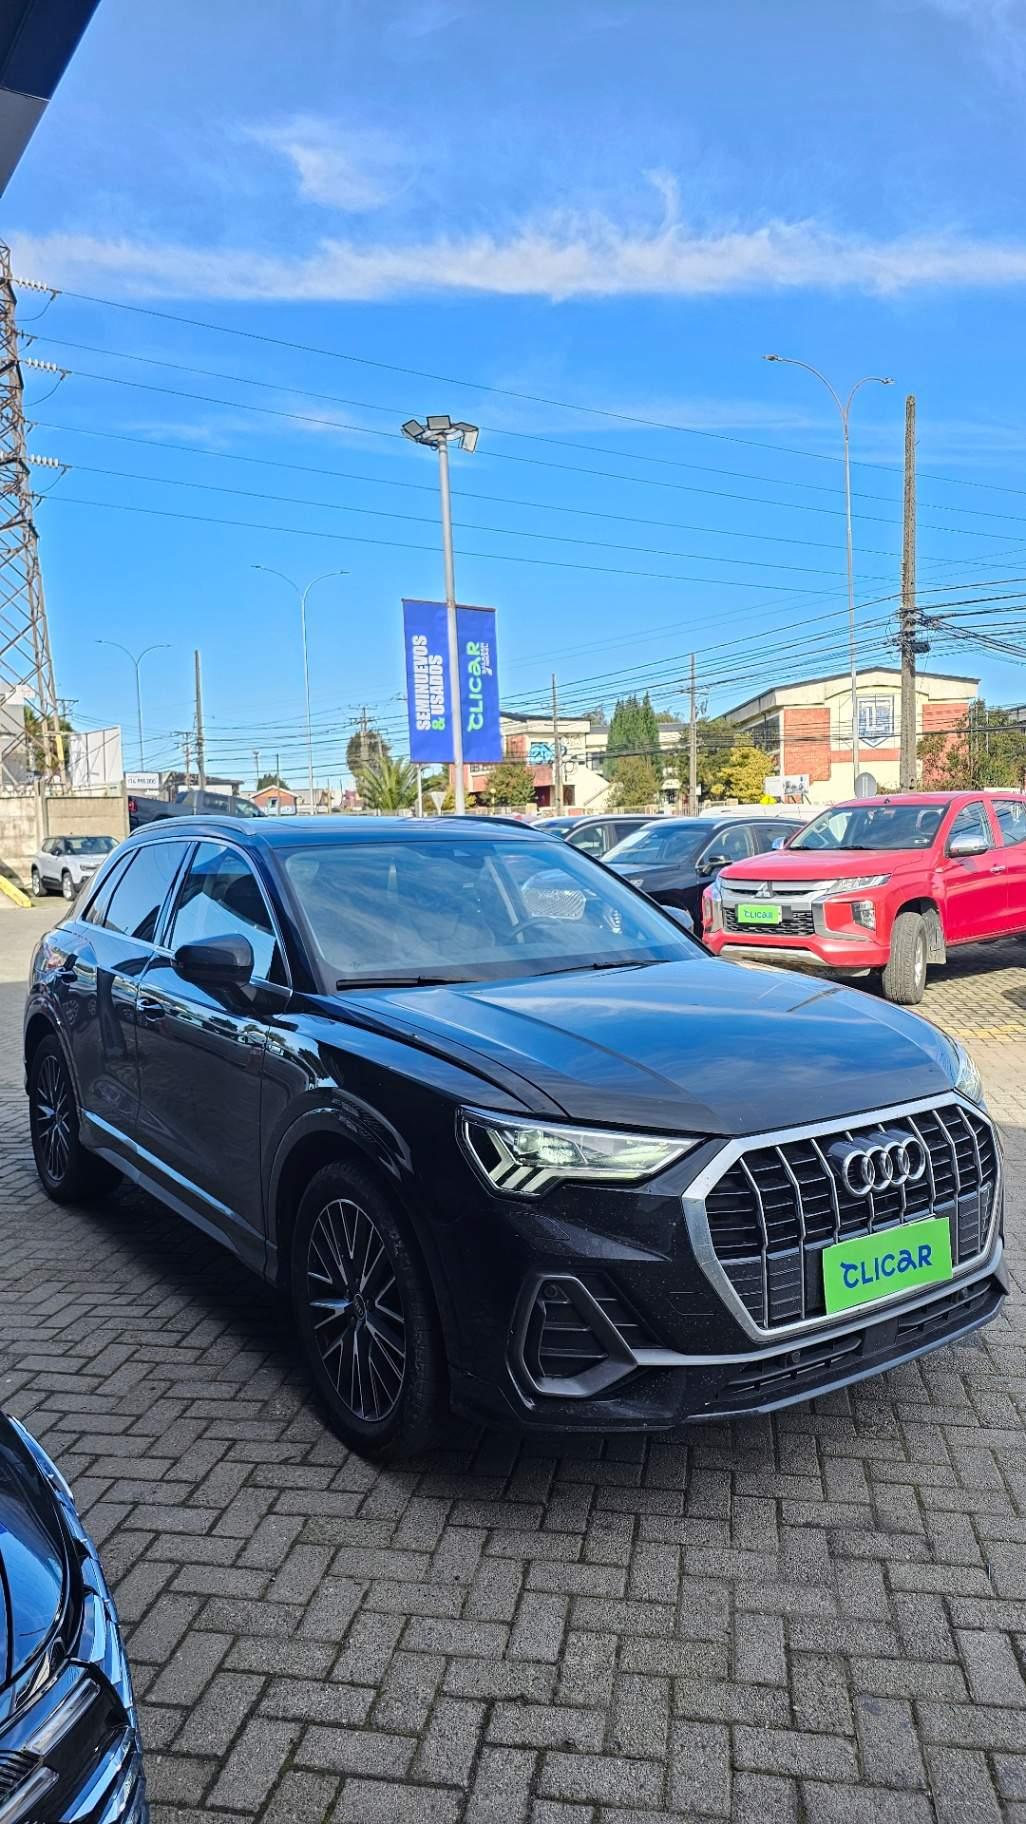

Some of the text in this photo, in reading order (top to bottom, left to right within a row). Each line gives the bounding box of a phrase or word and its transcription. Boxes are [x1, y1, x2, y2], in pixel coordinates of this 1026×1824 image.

[412, 635, 431, 731] SEMINUEVOS
[429, 654, 445, 730] & USADOS
